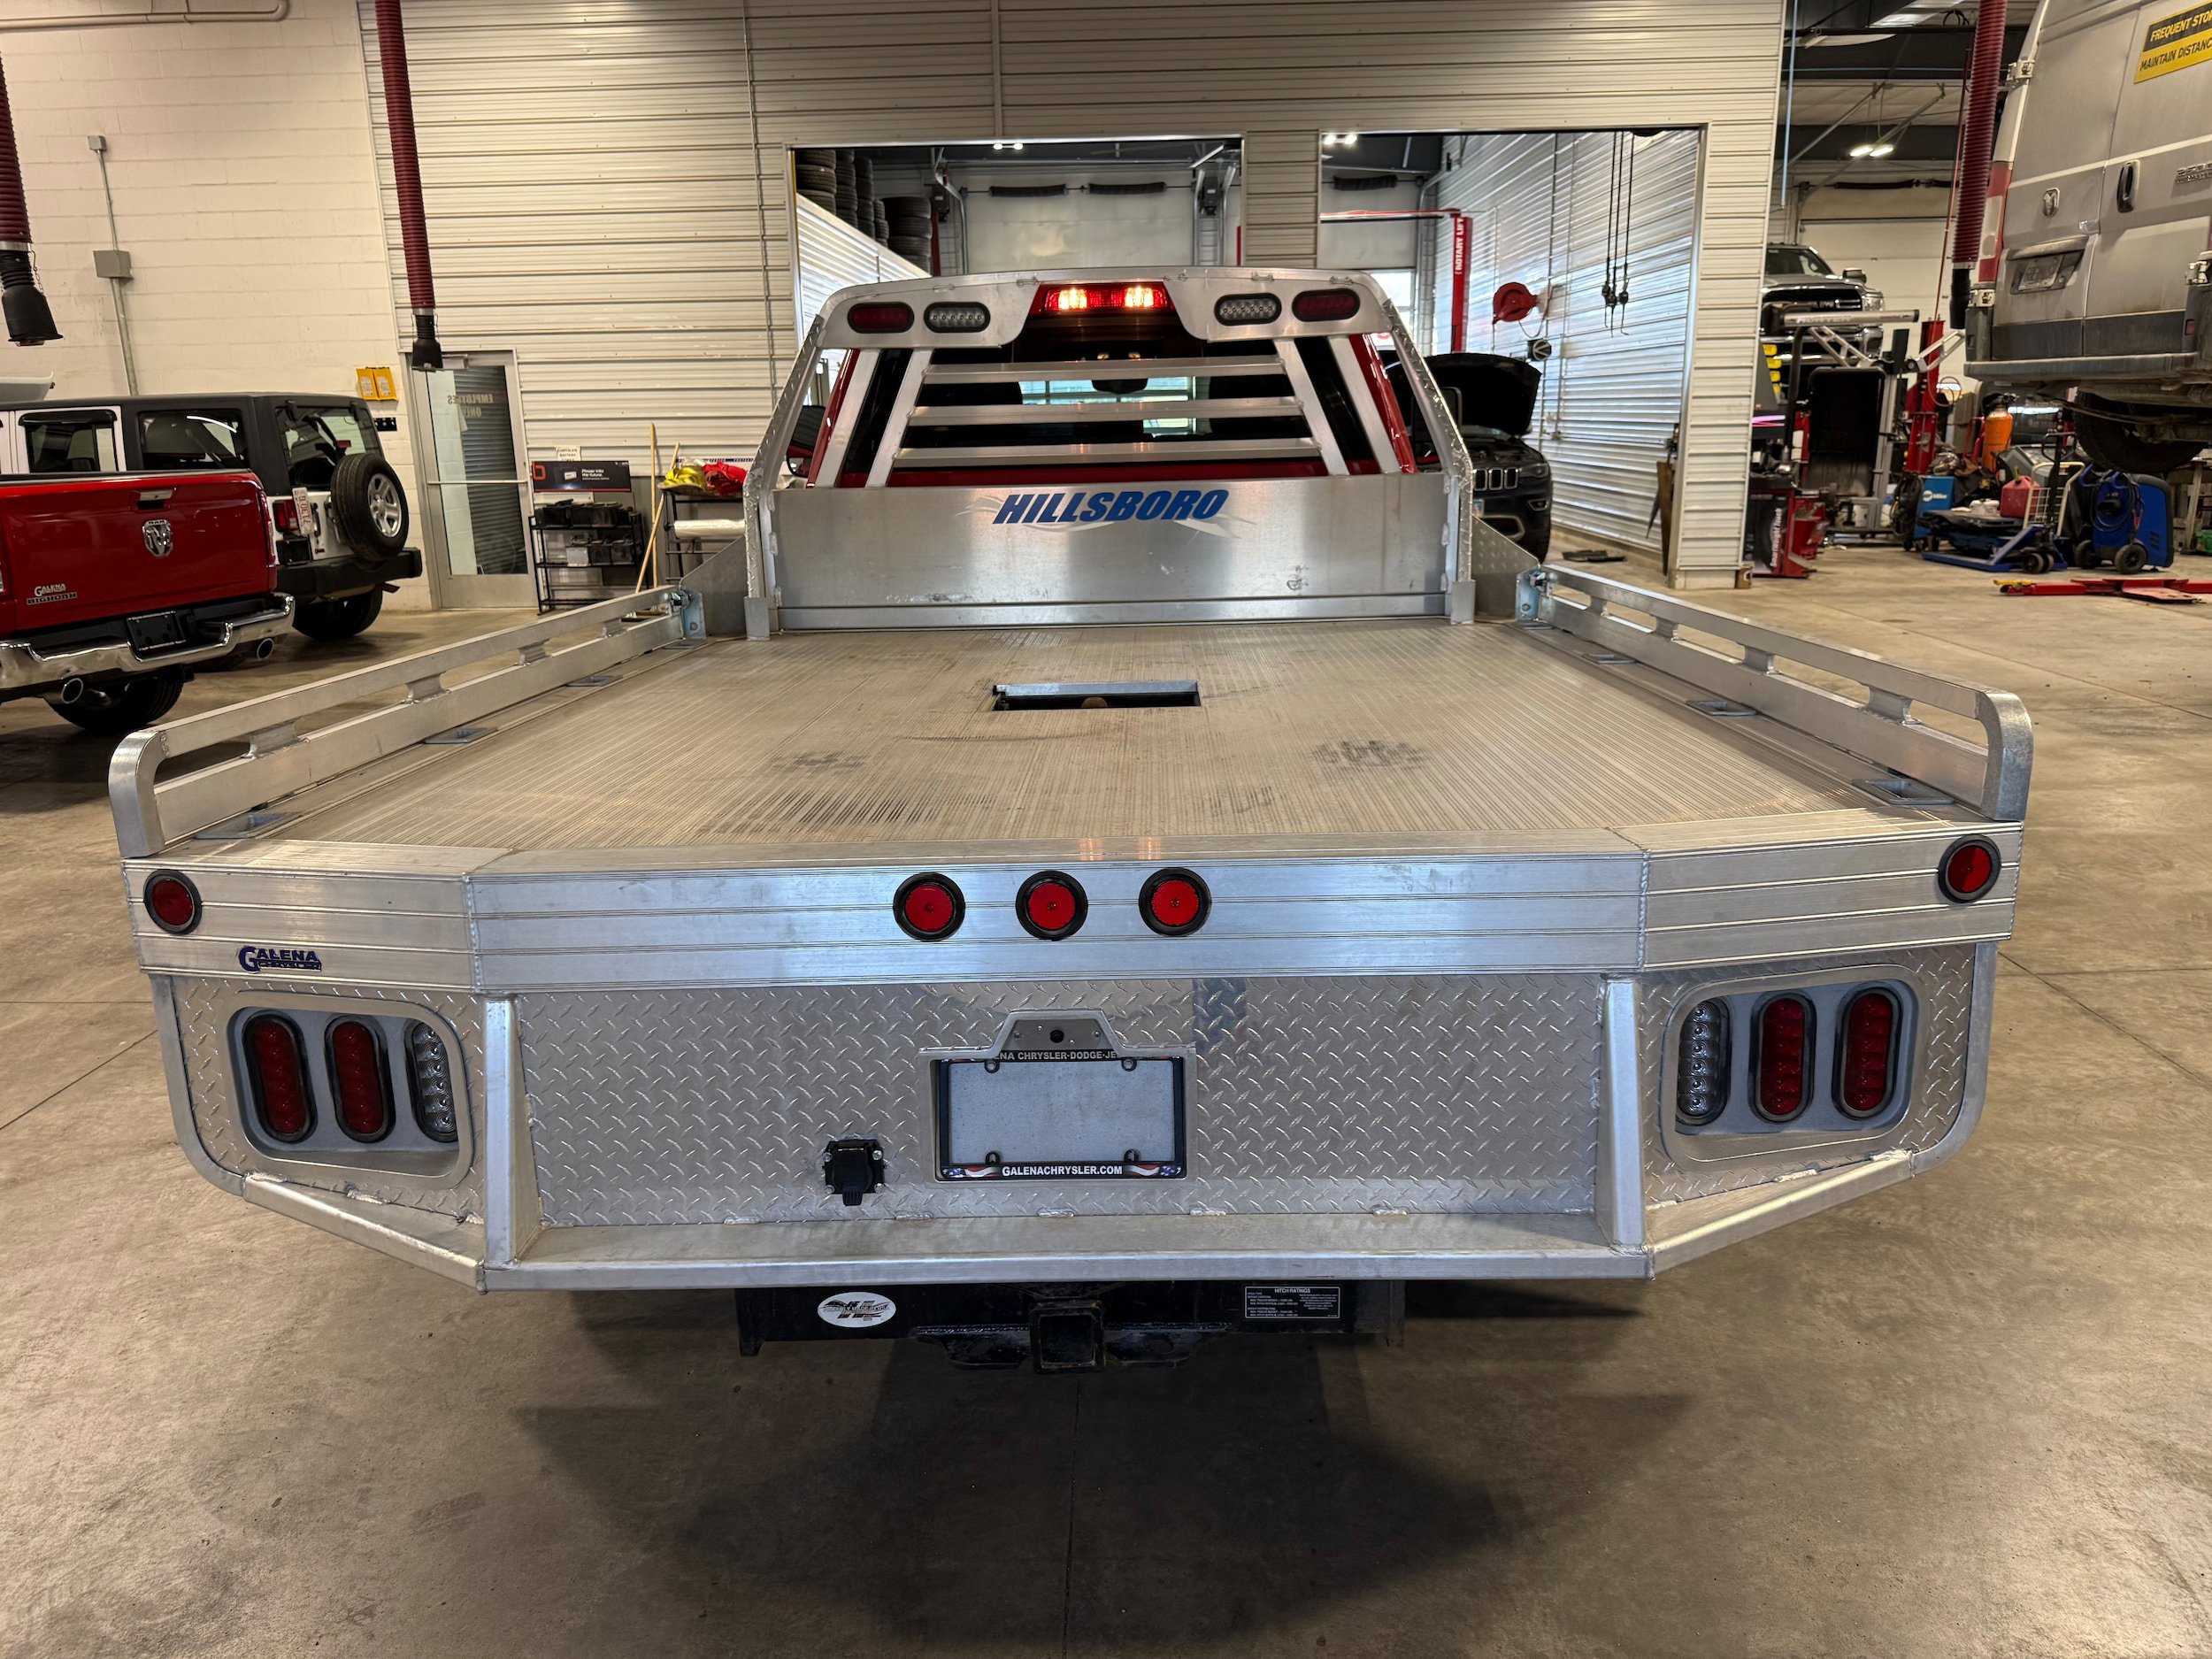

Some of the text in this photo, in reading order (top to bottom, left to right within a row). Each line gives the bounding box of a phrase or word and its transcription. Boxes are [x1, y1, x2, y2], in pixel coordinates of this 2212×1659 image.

[2150, 18, 2193, 42] FREQUENT
[2140, 50, 2177, 71] MAINTAIN
[992, 489, 1229, 525] HILLSBORO
[27, 594, 77, 604] BIGHORN
[35, 584, 66, 597] GALENA
[239, 946, 319, 972] GALENA
[1002, 1165, 1123, 1177] GALENACHRYSLER.COM
